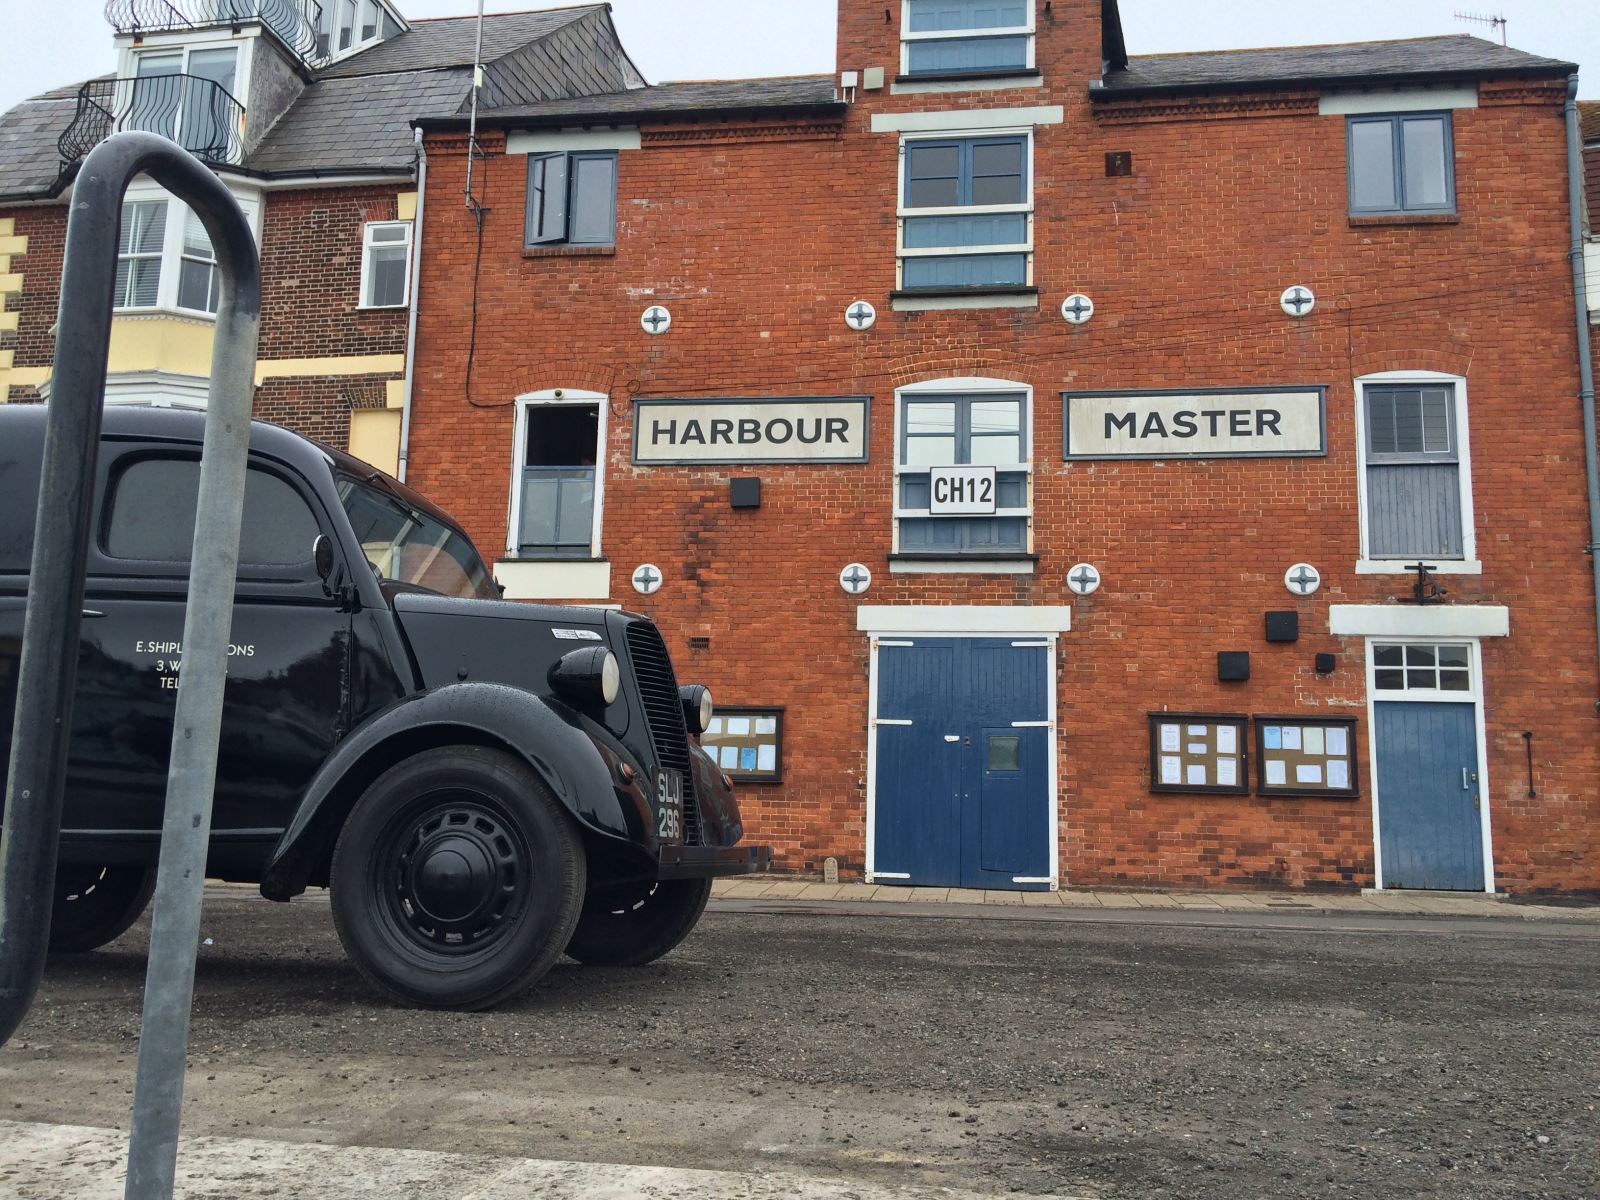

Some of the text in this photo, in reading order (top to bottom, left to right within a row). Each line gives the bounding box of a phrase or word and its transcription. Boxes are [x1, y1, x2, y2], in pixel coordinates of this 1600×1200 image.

[652, 417, 849, 444] HARBOUR
[1105, 409, 1282, 439] MASTER
[934, 477, 992, 503] CH12
[136, 641, 255, 657] E.SHIPL ONS
[658, 773, 679, 804] SLJ
[658, 808, 680, 838] 296
